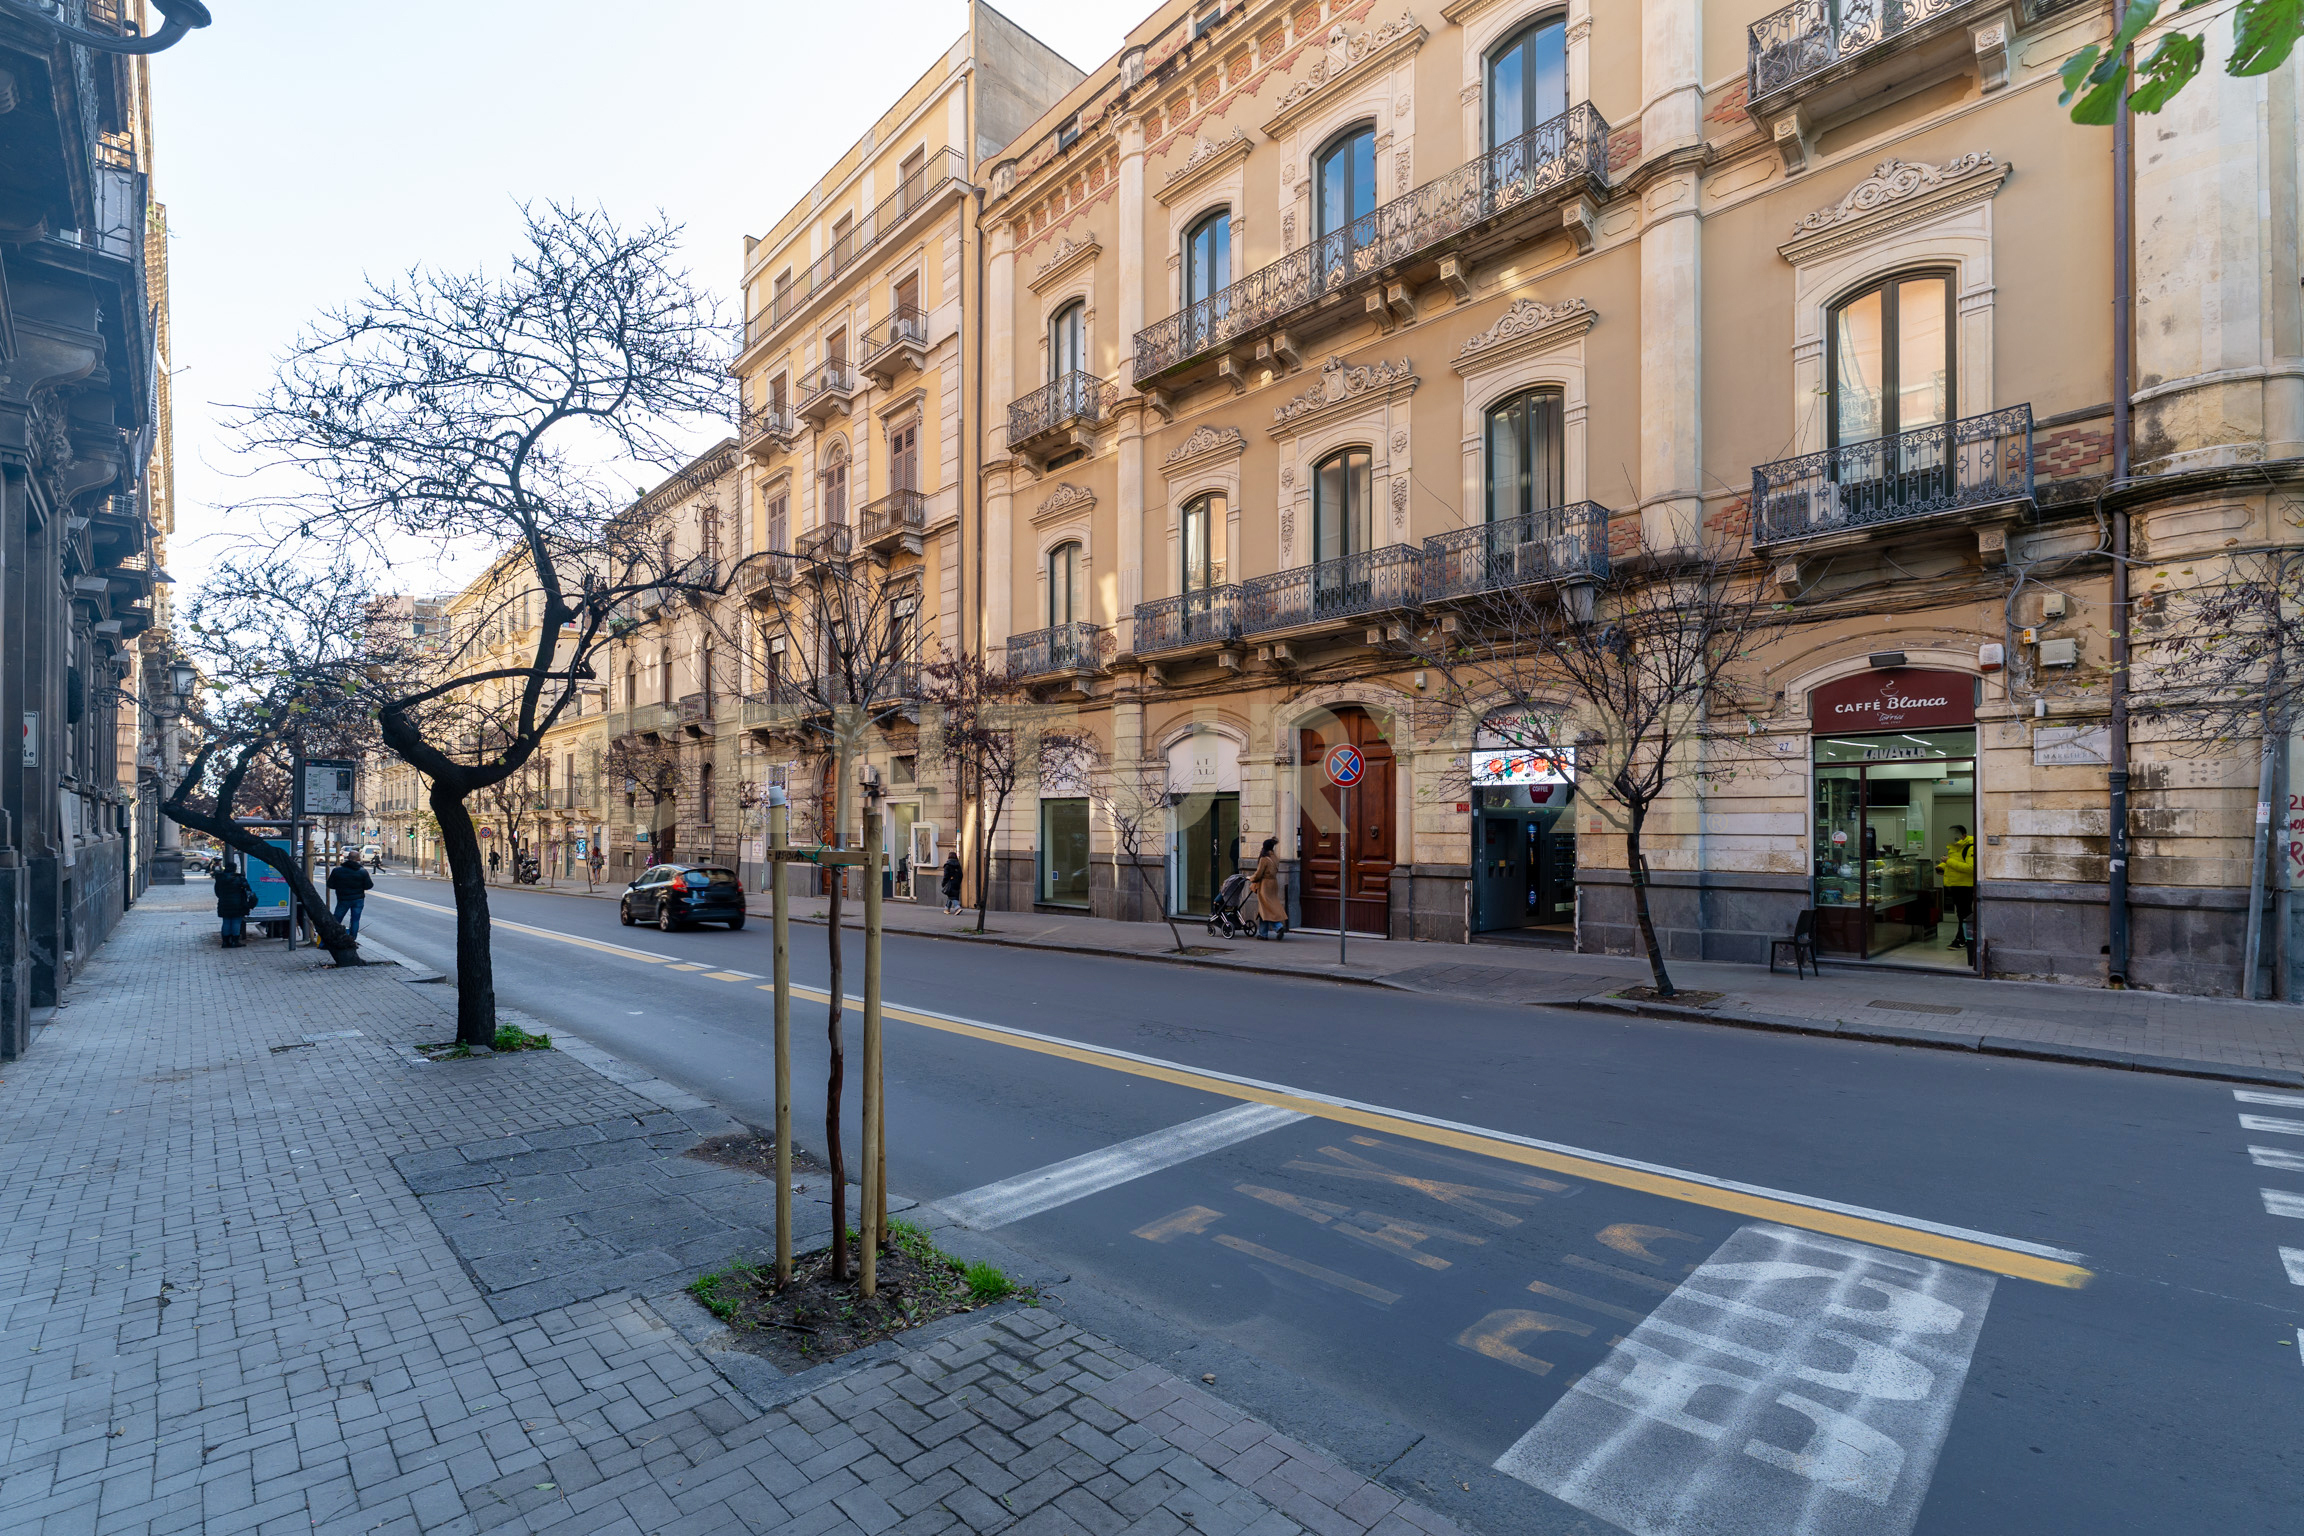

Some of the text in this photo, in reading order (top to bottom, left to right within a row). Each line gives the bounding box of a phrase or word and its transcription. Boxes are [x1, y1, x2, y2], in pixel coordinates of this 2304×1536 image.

[1835, 696, 1948, 714] CAFFÉ Blanca
[1779, 742, 1789, 751] 27
[1862, 744, 1927, 760] LAVAZZA
[1531, 785, 1549, 794] COFFEE
[1131, 1133, 1574, 1307] TAXI
